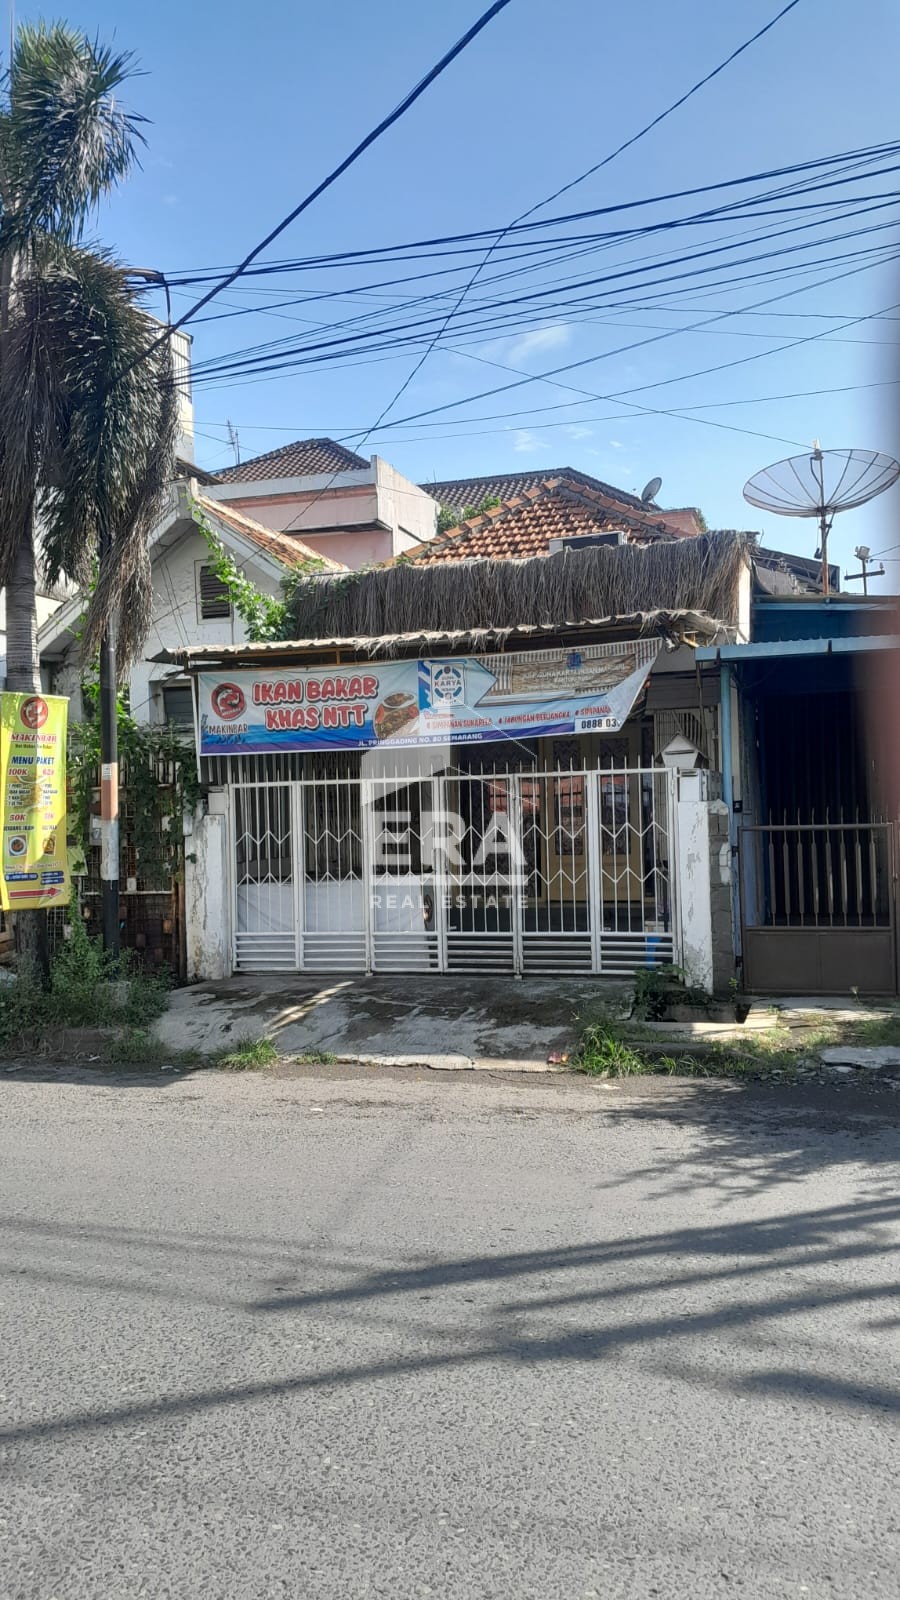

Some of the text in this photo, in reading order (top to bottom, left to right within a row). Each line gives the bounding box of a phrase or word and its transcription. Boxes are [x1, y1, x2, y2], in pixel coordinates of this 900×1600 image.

[253, 676, 379, 705] IKAN BAKAR
[265, 704, 368, 731] KHAS NTT
[208, 723, 249, 735] MAKINBAR
[582, 718, 603, 729] 0888
[419, 735, 432, 743] NO.
[443, 732, 483, 742] SEMARANG
[12, 756, 55, 765] MENU PAKET
[8, 768, 27, 776] 100K
[9, 813, 26, 821] 50K
